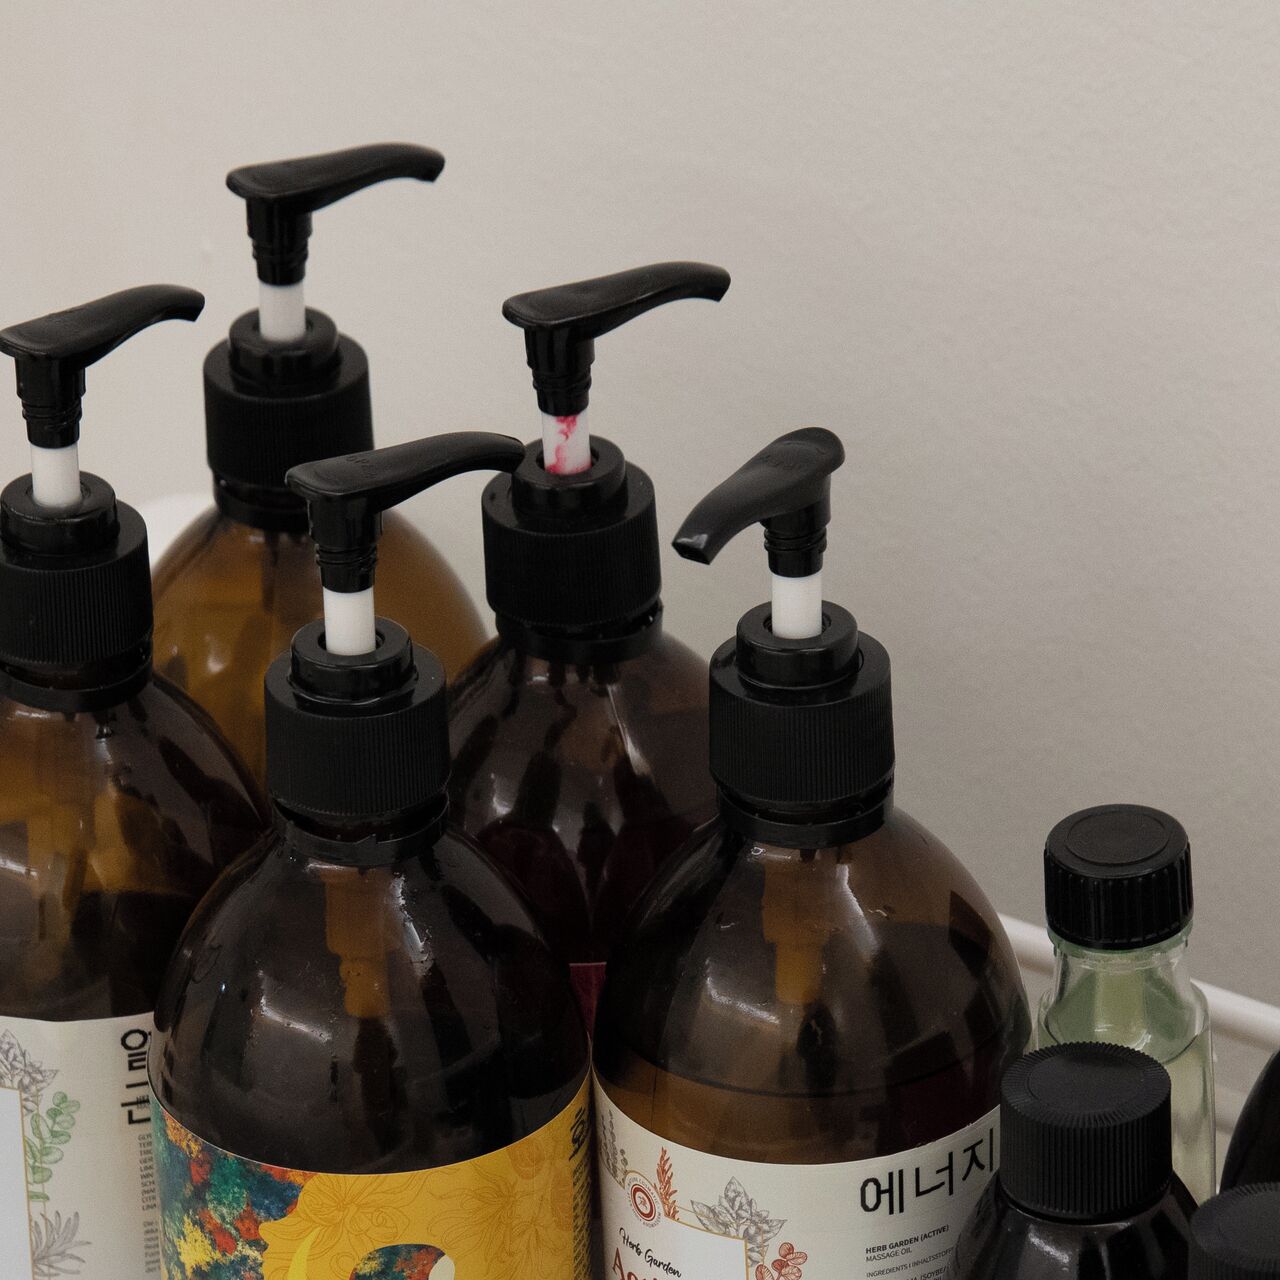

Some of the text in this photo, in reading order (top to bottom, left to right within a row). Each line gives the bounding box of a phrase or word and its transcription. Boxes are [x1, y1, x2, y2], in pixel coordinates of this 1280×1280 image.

[861, 1128, 993, 1215] 에너지
[619, 1227, 681, 1278] Herb Garden
[866, 1224, 949, 1254] HERB GARDEN (ACTIVE)
[866, 1247, 912, 1262] MASSAGE OIL
[866, 1263, 908, 1278] INGREDIENTS
